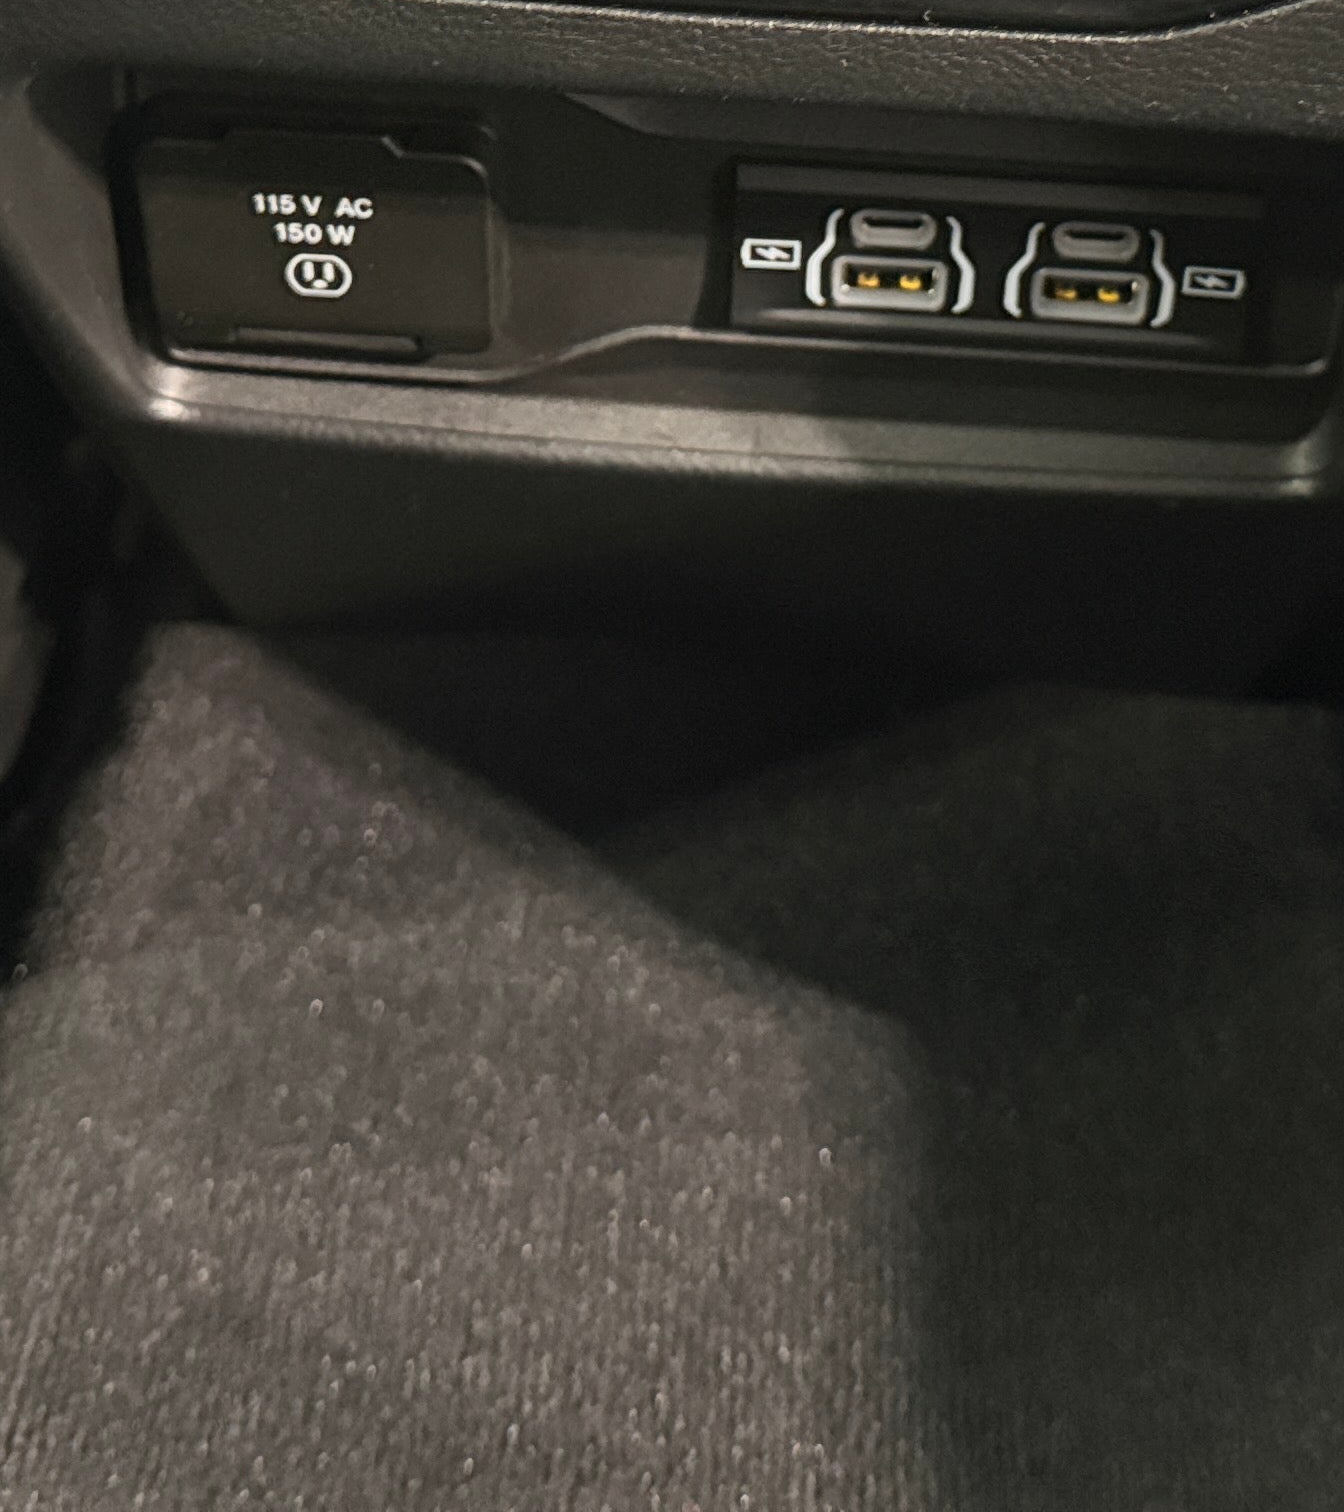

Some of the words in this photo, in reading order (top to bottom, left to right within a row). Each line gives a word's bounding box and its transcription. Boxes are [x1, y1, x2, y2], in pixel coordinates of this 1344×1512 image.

[253, 193, 297, 215] 115
[301, 194, 322, 216] V
[334, 197, 374, 219] AC
[274, 223, 323, 245] 150
[326, 224, 356, 246] W
